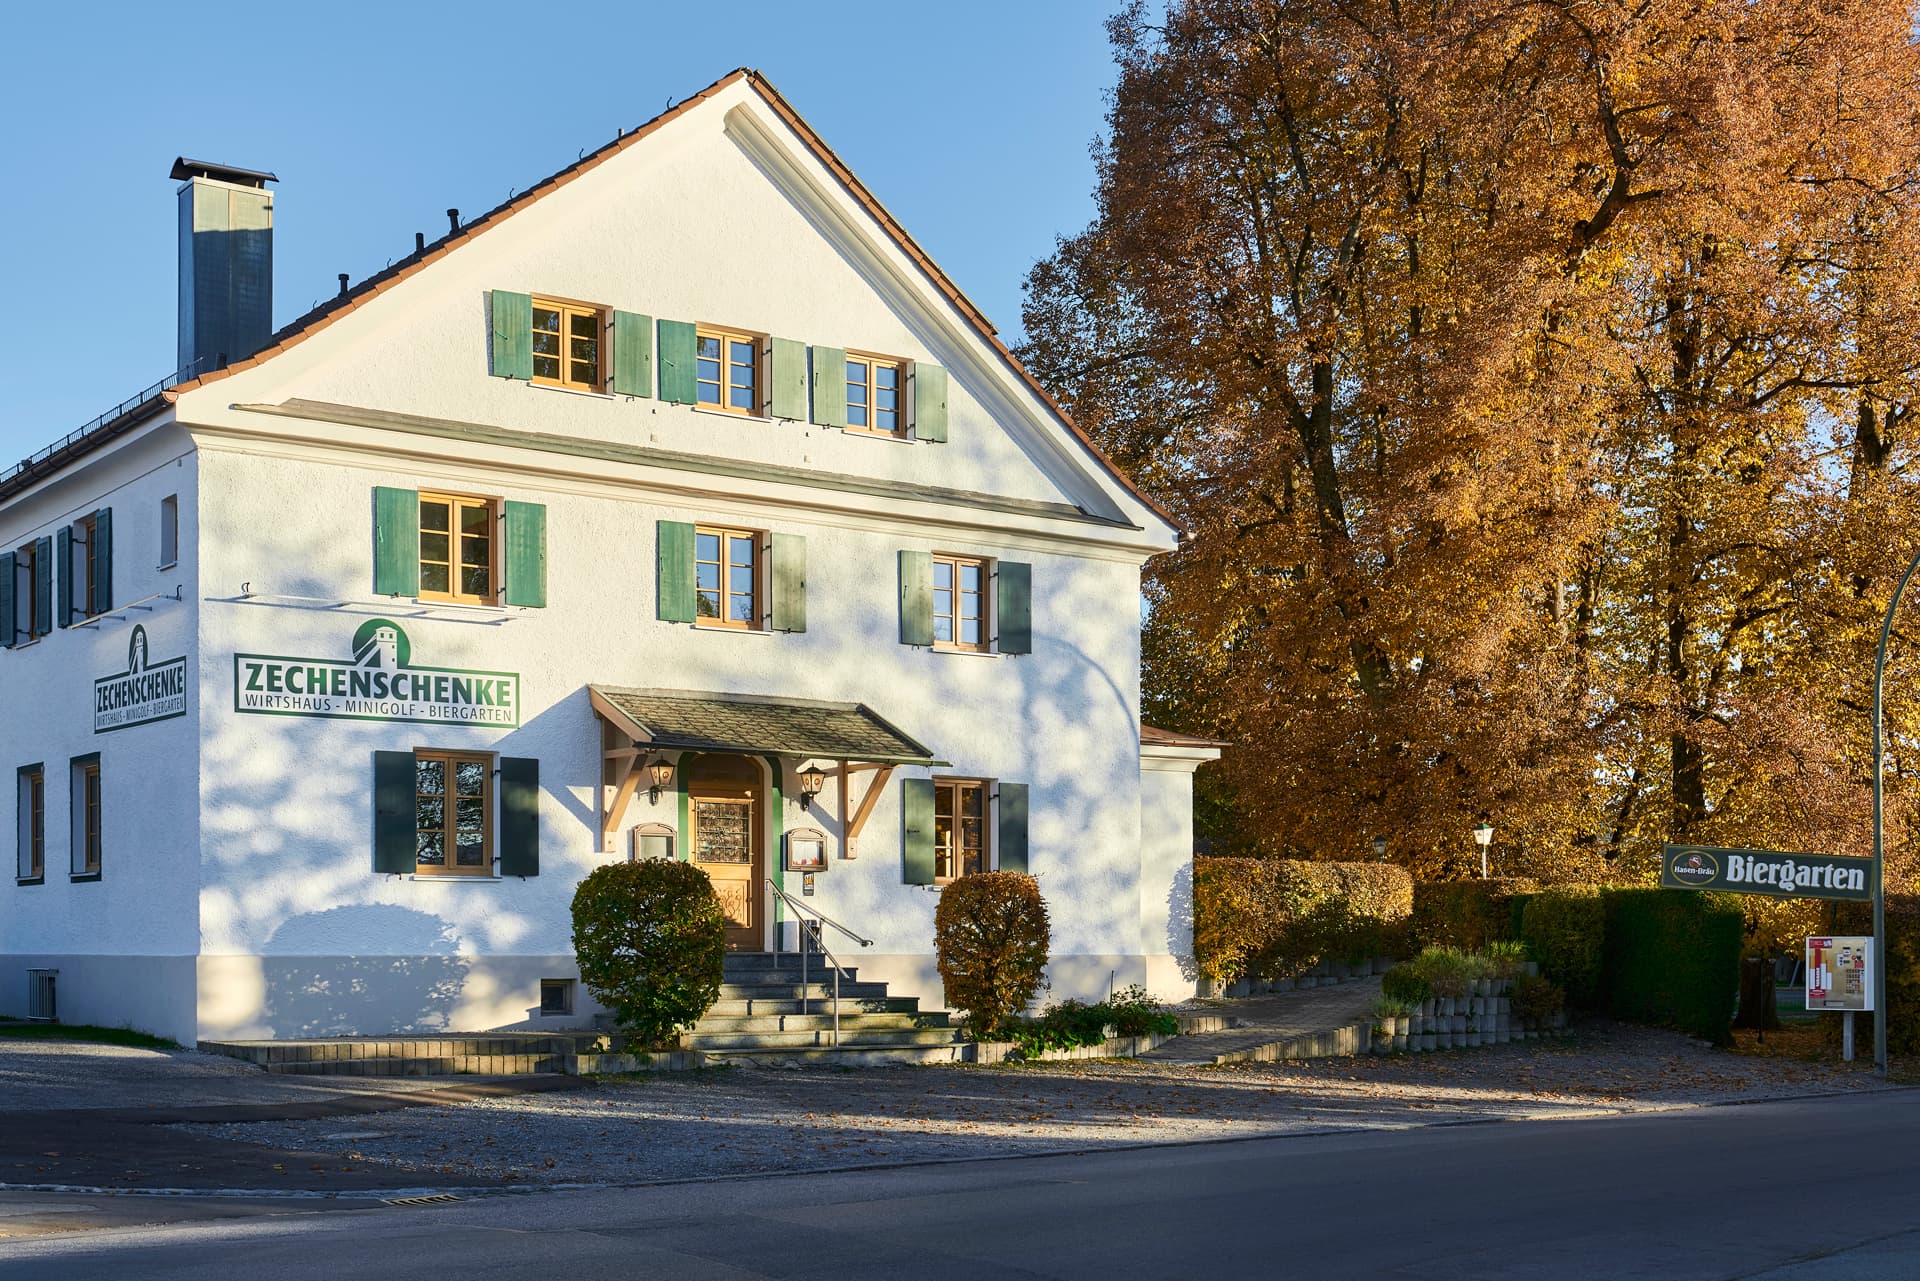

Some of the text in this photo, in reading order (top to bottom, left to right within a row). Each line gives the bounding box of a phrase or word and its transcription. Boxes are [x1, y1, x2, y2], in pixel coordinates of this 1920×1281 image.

[97, 666, 184, 713] ZECHENSCHENKE
[245, 663, 511, 707] ZECHENSCHENKE
[153, 696, 184, 715] BIERGARTEN
[245, 694, 331, 711] WIRTSHAUS
[345, 700, 416, 716] MINIGOLF
[429, 705, 512, 721] BIERGARTEN
[1727, 855, 1864, 891] Biergarten
